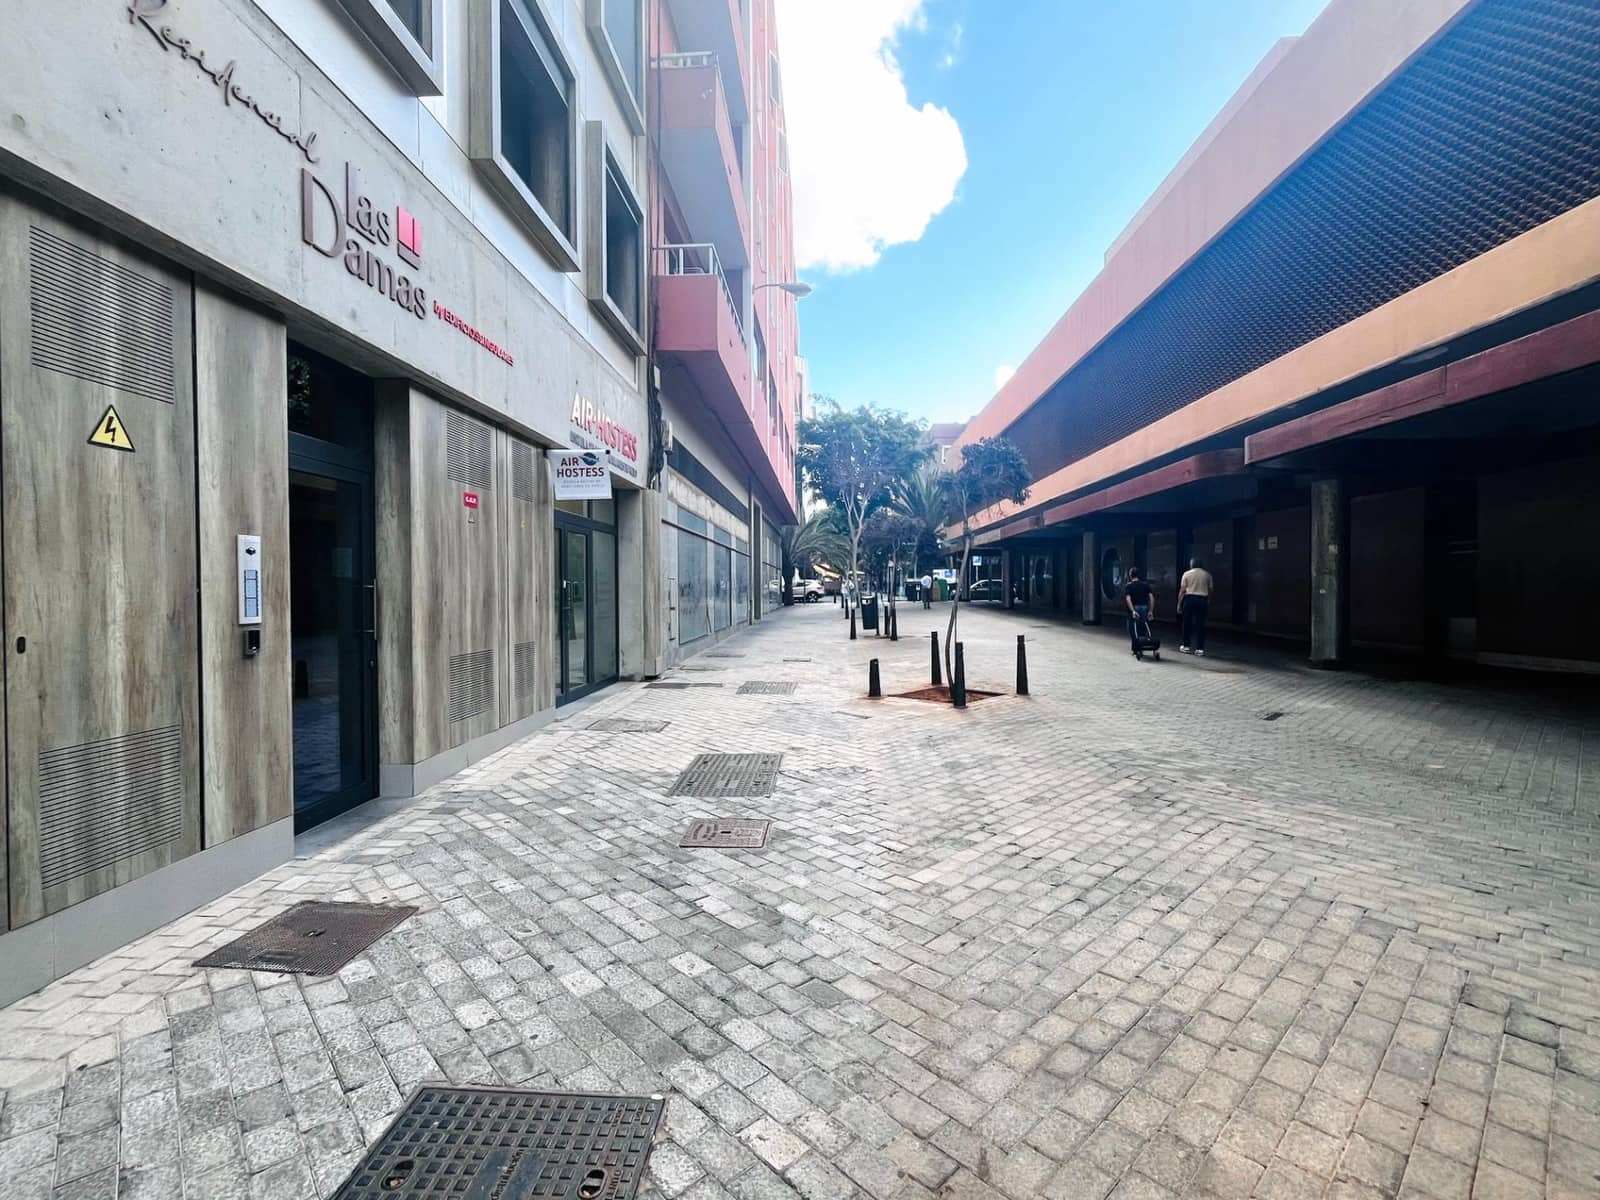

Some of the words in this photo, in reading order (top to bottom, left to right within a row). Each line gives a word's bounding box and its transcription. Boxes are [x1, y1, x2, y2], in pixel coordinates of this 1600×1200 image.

[345, 161, 391, 246] Las
[301, 168, 427, 321] Damas
[556, 467, 605, 478] HOSTESS
[560, 457, 580, 467] AIR
